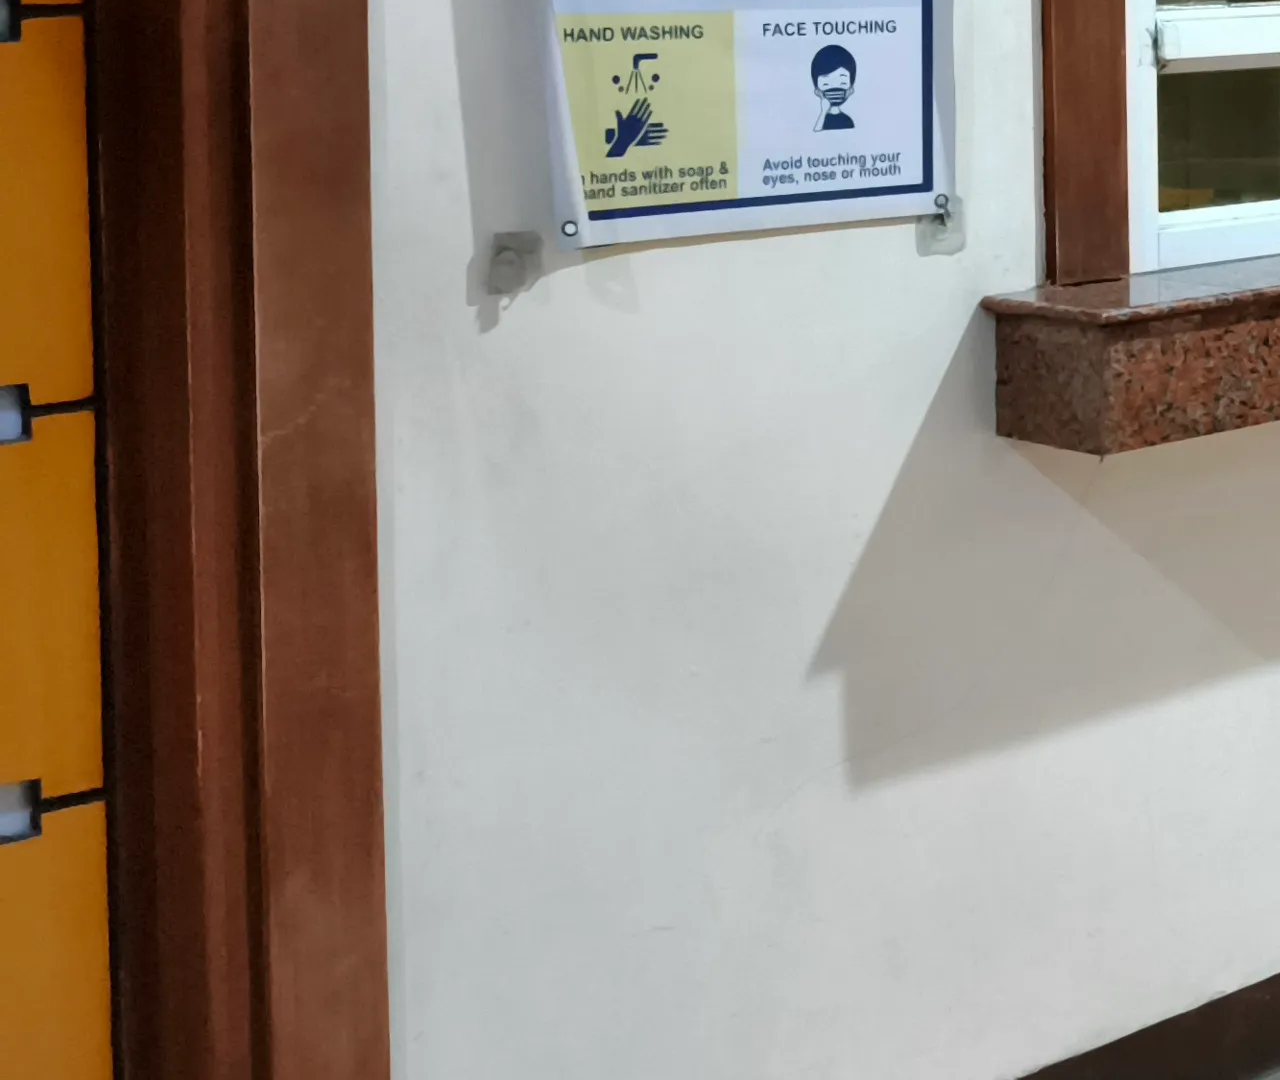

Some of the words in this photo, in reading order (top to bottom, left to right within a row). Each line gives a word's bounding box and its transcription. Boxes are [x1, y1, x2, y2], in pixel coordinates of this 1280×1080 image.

[563, 27, 615, 43] HAND
[620, 24, 705, 41] WASHING
[762, 22, 807, 37] FACE
[813, 19, 898, 36] TOUCHING
[762, 156, 802, 171] Avoid
[807, 152, 867, 169] touching
[871, 151, 901, 167] your
[590, 168, 637, 185] hands
[641, 165, 673, 180] with
[678, 165, 714, 179] soap
[719, 160, 729, 175] &
[762, 173, 799, 188] eyes,
[804, 170, 837, 183] nose
[841, 168, 854, 180] or
[859, 164, 902, 178] mouth
[620, 180, 686, 197] sanitizer
[690, 177, 728, 191] often
